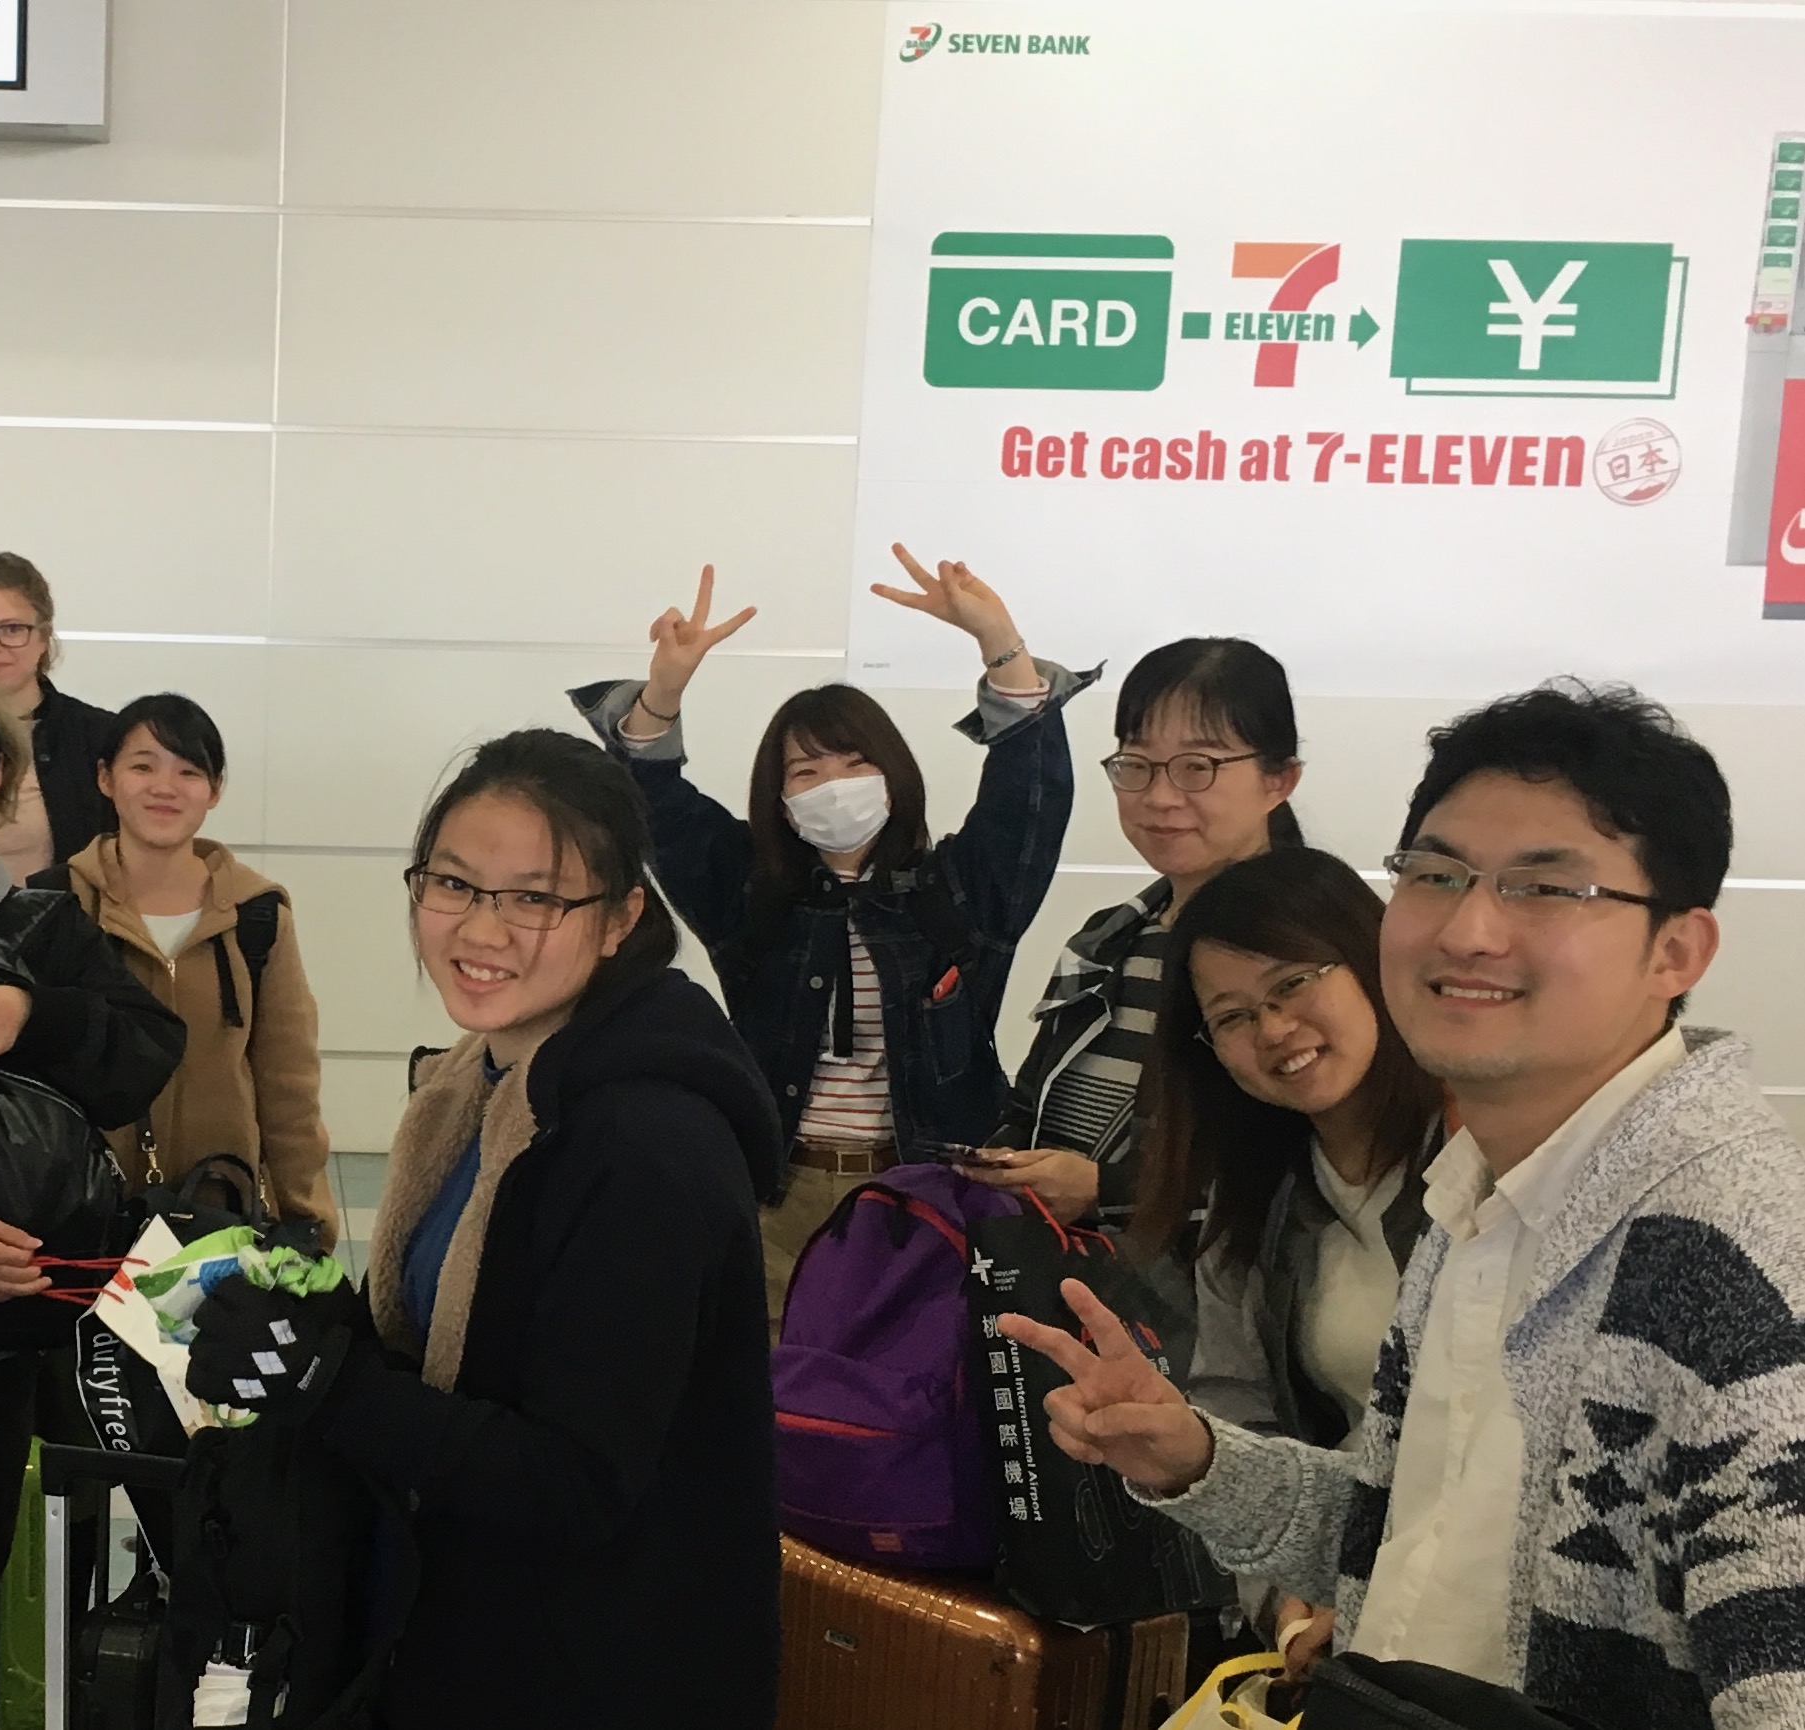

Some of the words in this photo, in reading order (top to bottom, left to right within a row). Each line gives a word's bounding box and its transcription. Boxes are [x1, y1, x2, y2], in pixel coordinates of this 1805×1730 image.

[948, 33, 1021, 54] SEVEN
[1027, 35, 1091, 55] BANK
[957, 298, 1138, 347] CARD
[1232, 242, 1341, 387] 7
[1001, 425, 1088, 480] Get
[1101, 430, 1224, 482] cash
[1239, 431, 1291, 482] at
[1607, 442, 1668, 481] 日本
[1015, 1377, 1034, 1468] International
[1027, 1470, 1043, 1522] Airport
